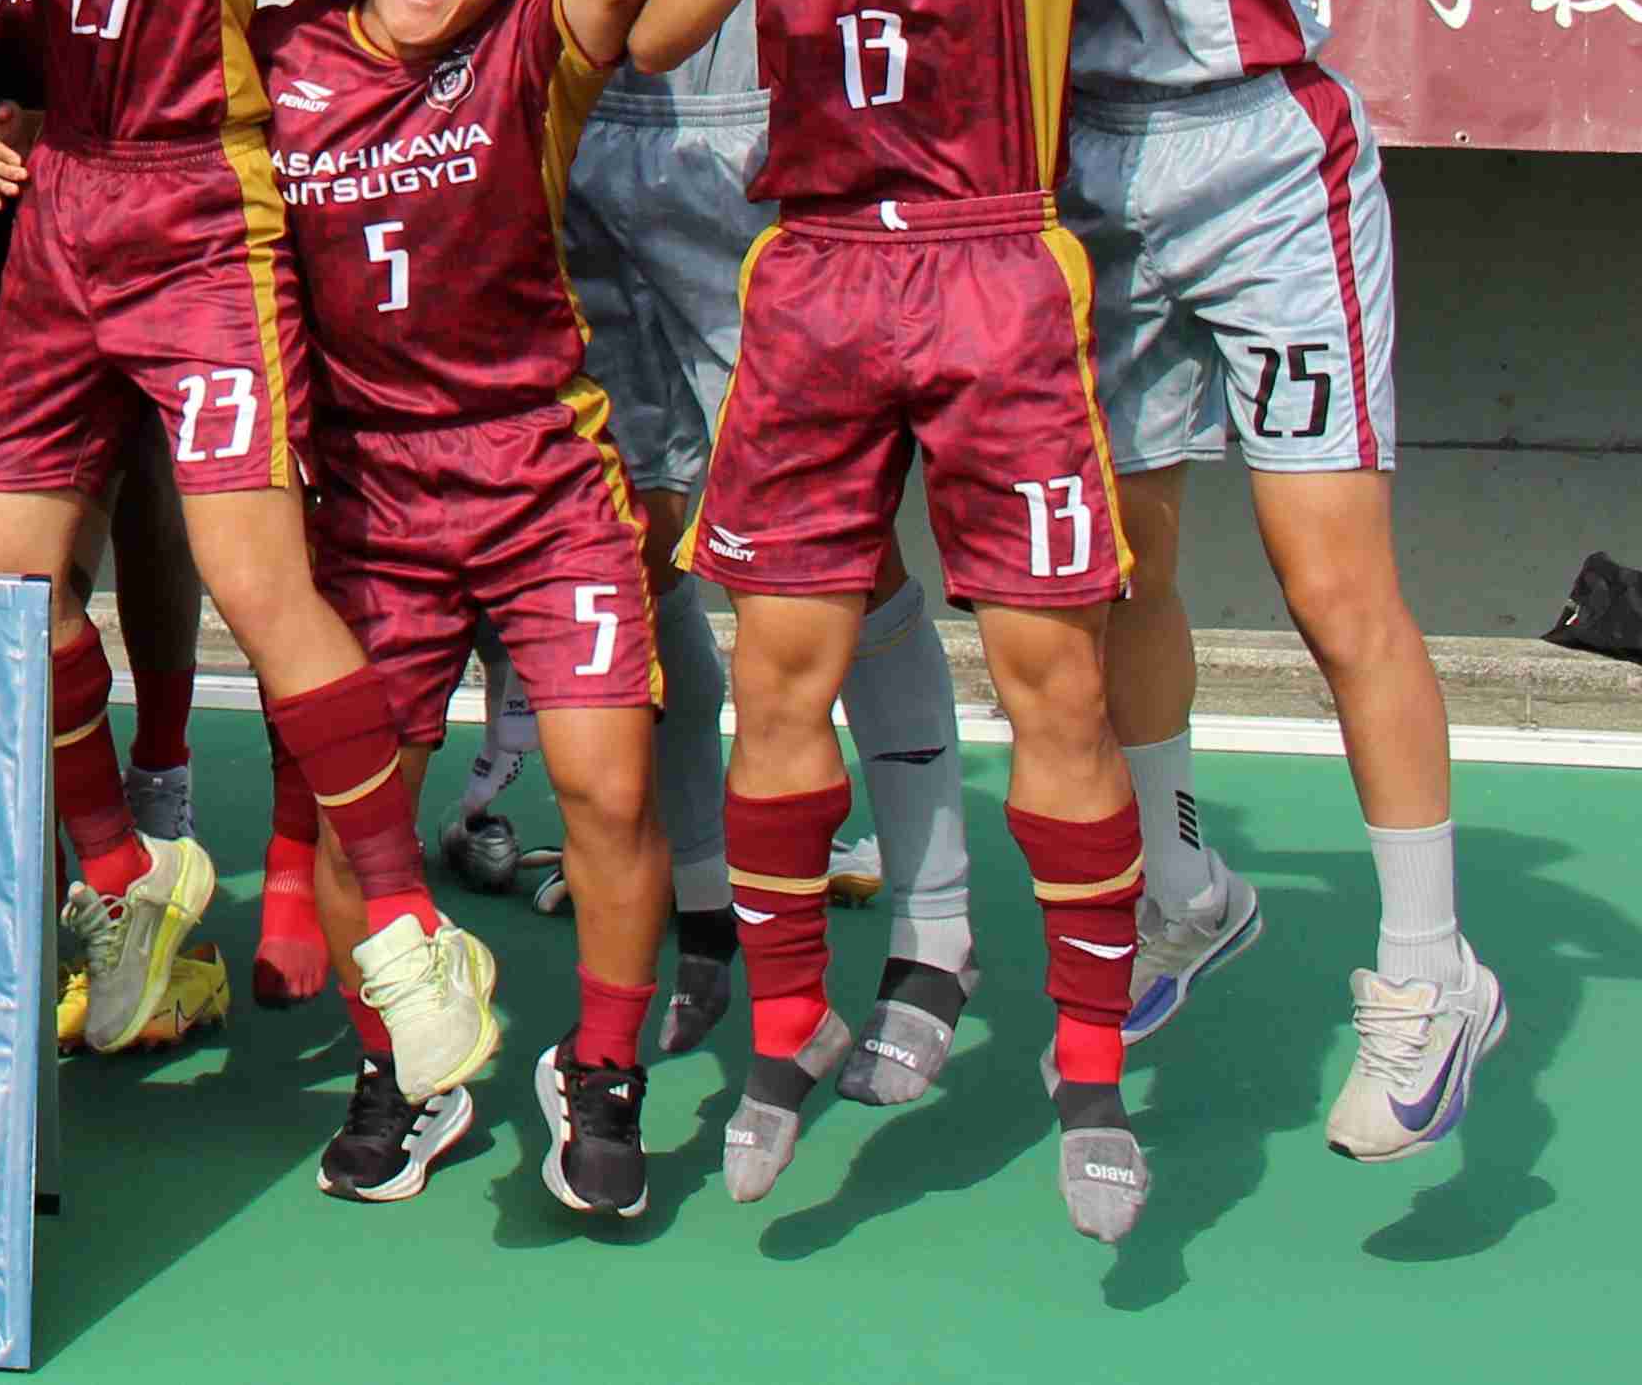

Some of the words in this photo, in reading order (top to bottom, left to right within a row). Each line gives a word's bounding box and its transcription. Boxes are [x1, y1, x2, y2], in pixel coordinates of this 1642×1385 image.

[276, 92, 330, 113] PENALTY
[835, 8, 910, 110] 13
[271, 122, 492, 178] ASAHIKAWA
[282, 156, 478, 206] JITSUGYO
[362, 220, 411, 314] 5
[174, 367, 258, 463] 23
[1245, 342, 1333, 438] 25
[707, 537, 756, 563] PENALTY
[1012, 475, 1093, 577] 13
[572, 584, 620, 678] 5
